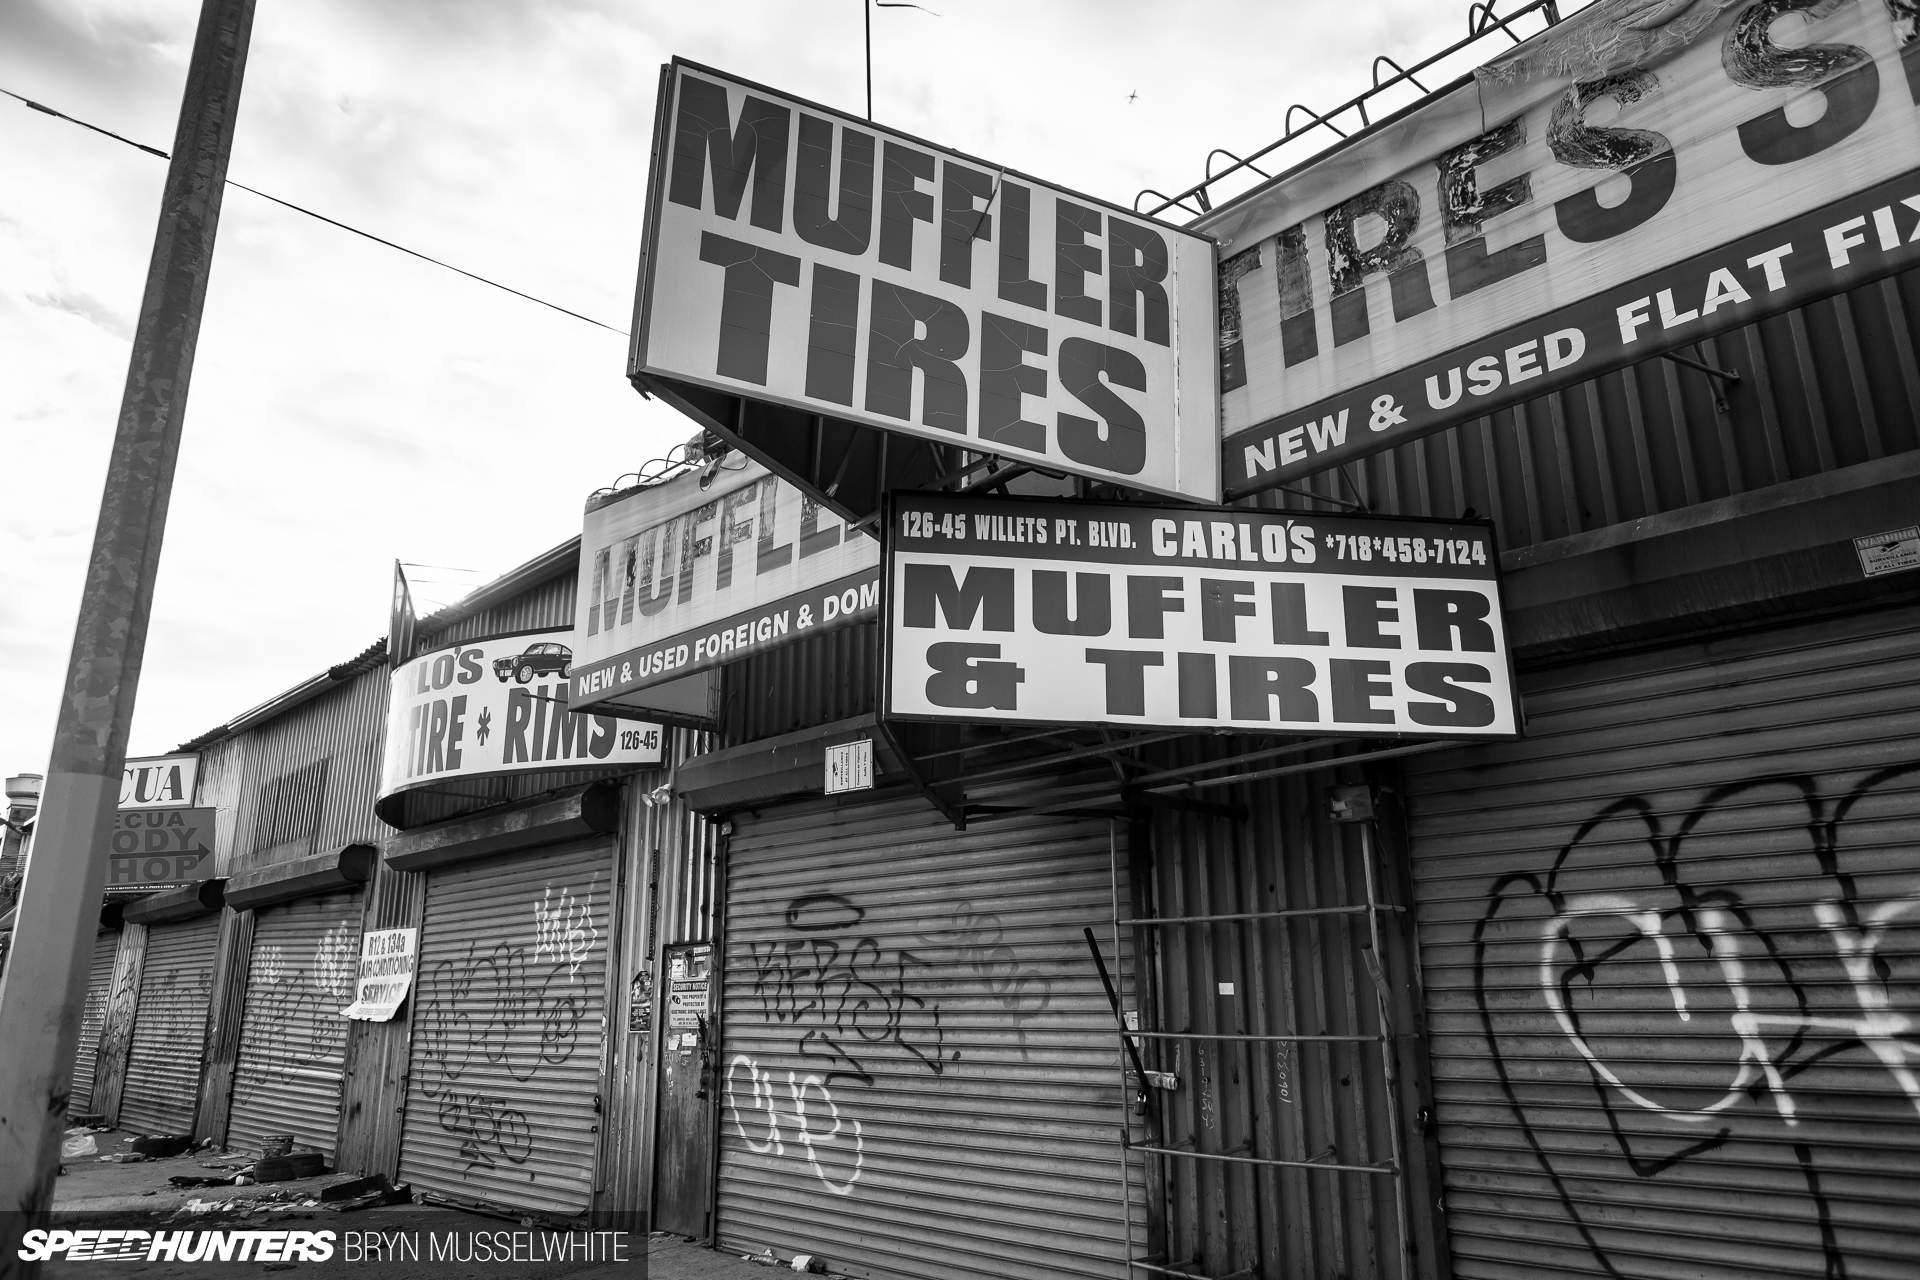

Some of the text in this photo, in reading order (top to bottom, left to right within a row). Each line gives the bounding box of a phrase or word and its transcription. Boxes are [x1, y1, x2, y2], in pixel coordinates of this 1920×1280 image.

[669, 73, 1170, 348] MUFFLER
[1218, 67, 1677, 394] TIRES
[699, 230, 1147, 475] TIRES
[1244, 408, 1349, 478] NEW
[1369, 394, 1407, 433] &
[1424, 327, 1587, 410] USED
[1616, 243, 1795, 344] FLAT
[901, 511, 967, 540] 126-45
[975, 513, 1048, 546] WILLETS
[1055, 519, 1082, 547] PT.
[1088, 520, 1137, 549] BLVD.
[1151, 518, 1316, 564] CARLO'S
[1857, 530, 1917, 547] WARNING
[1869, 551, 1918, 564] SURVEILLANCE
[903, 563, 1497, 653] MUFFLER
[578, 668, 617, 697] NEW
[620, 661, 633, 684] &
[639, 644, 689, 678] USED
[694, 610, 789, 662] FOREIGN
[796, 604, 814, 629] &
[925, 641, 1496, 728] & TIRES
[407, 683, 658, 779] TIRE RIMS 126-45
[110, 856, 198, 884] HOP
[111, 828, 198, 854] ODY
[361, 982, 404, 1004] SERVICE
[372, 954, 414, 977] CONDITIONING
[673, 982, 707, 991] SECURITY NOTICE
